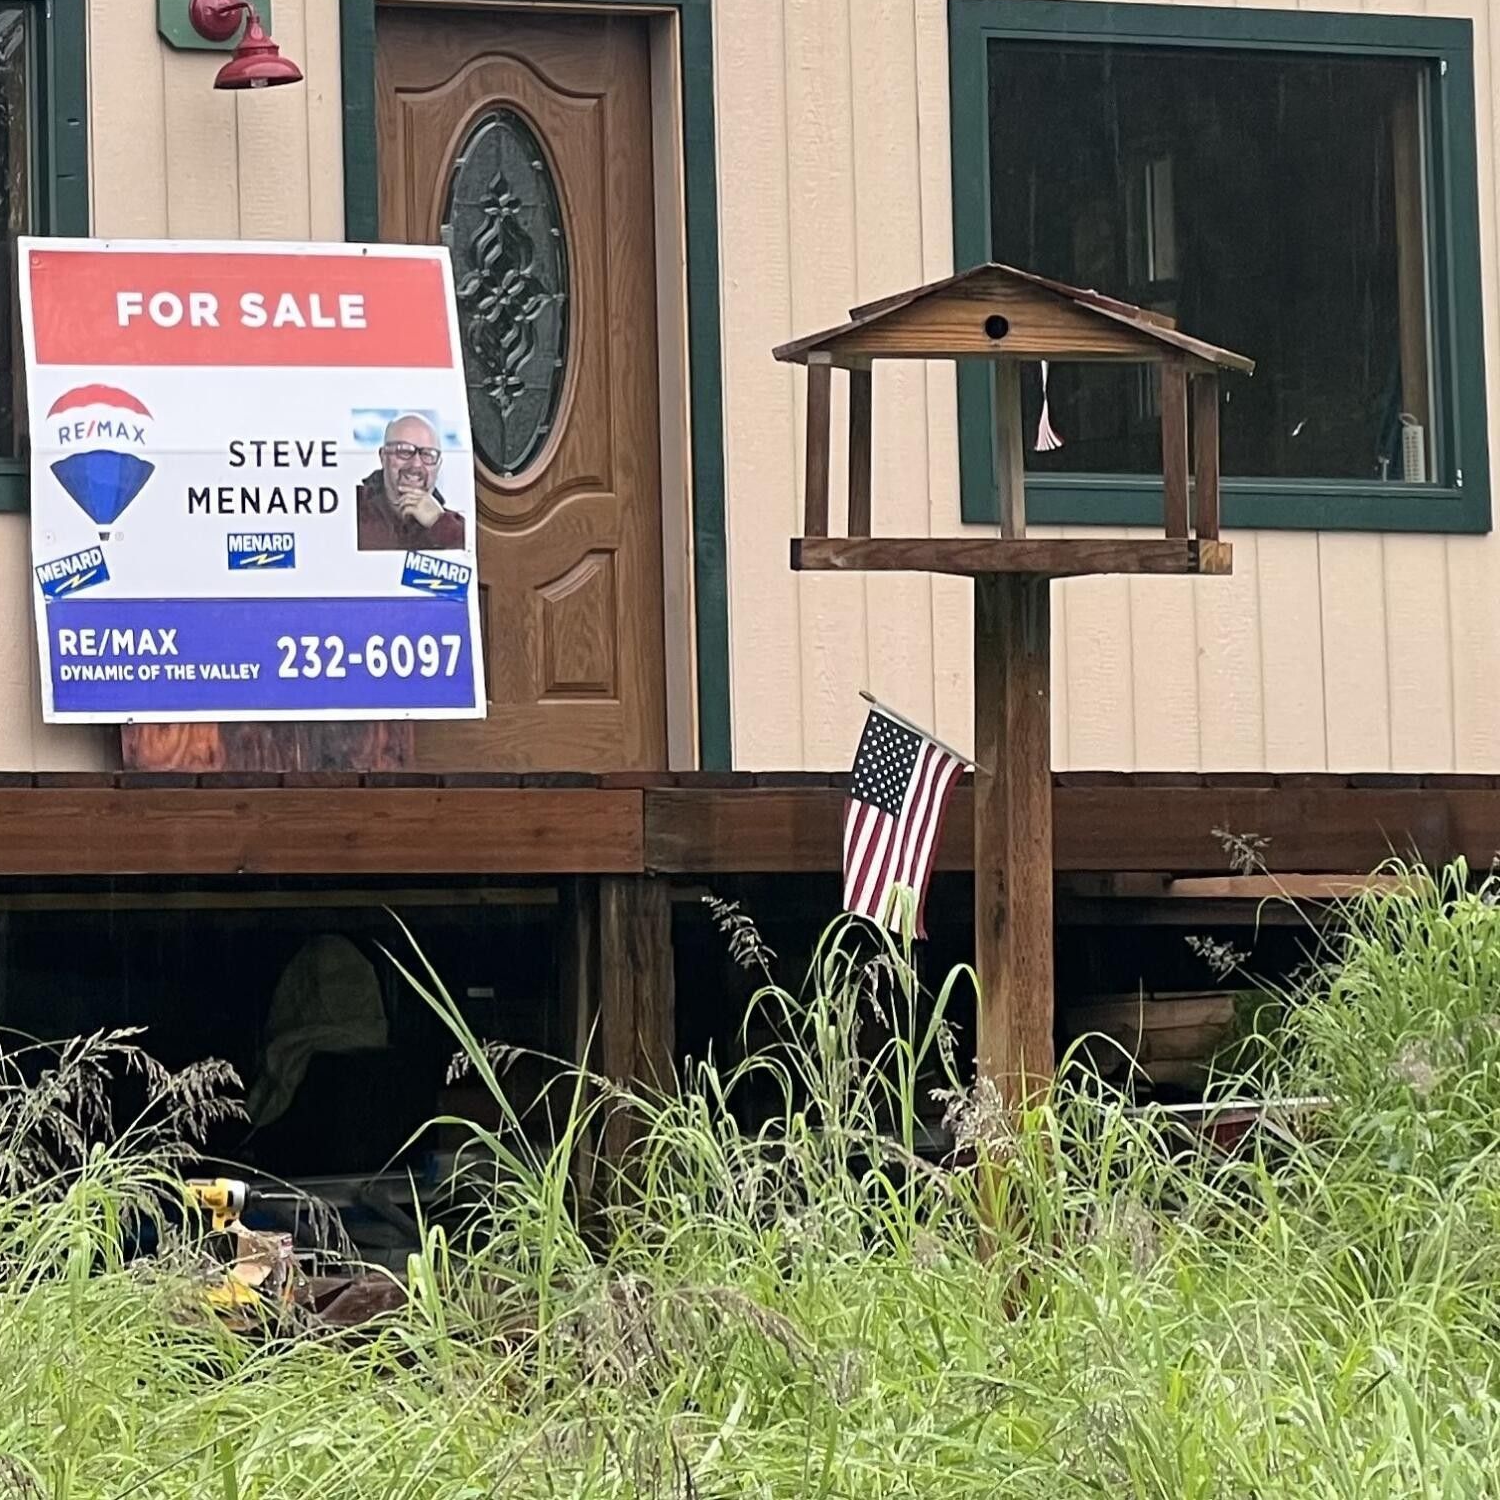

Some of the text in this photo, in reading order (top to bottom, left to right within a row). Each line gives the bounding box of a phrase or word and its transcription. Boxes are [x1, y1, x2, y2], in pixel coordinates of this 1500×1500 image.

[117, 291, 367, 328] FOR SALE
[58, 419, 146, 445] RE/MAX
[229, 441, 338, 468] STEVE
[188, 486, 339, 514] MENARD
[229, 534, 293, 551] MENARD
[37, 548, 103, 584] MENARD
[407, 555, 470, 584] MENARD
[59, 629, 178, 655] RE/MAX
[277, 635, 461, 678] 232-6097
[60, 664, 260, 681] DYNAMIC OF THE VALLEY
